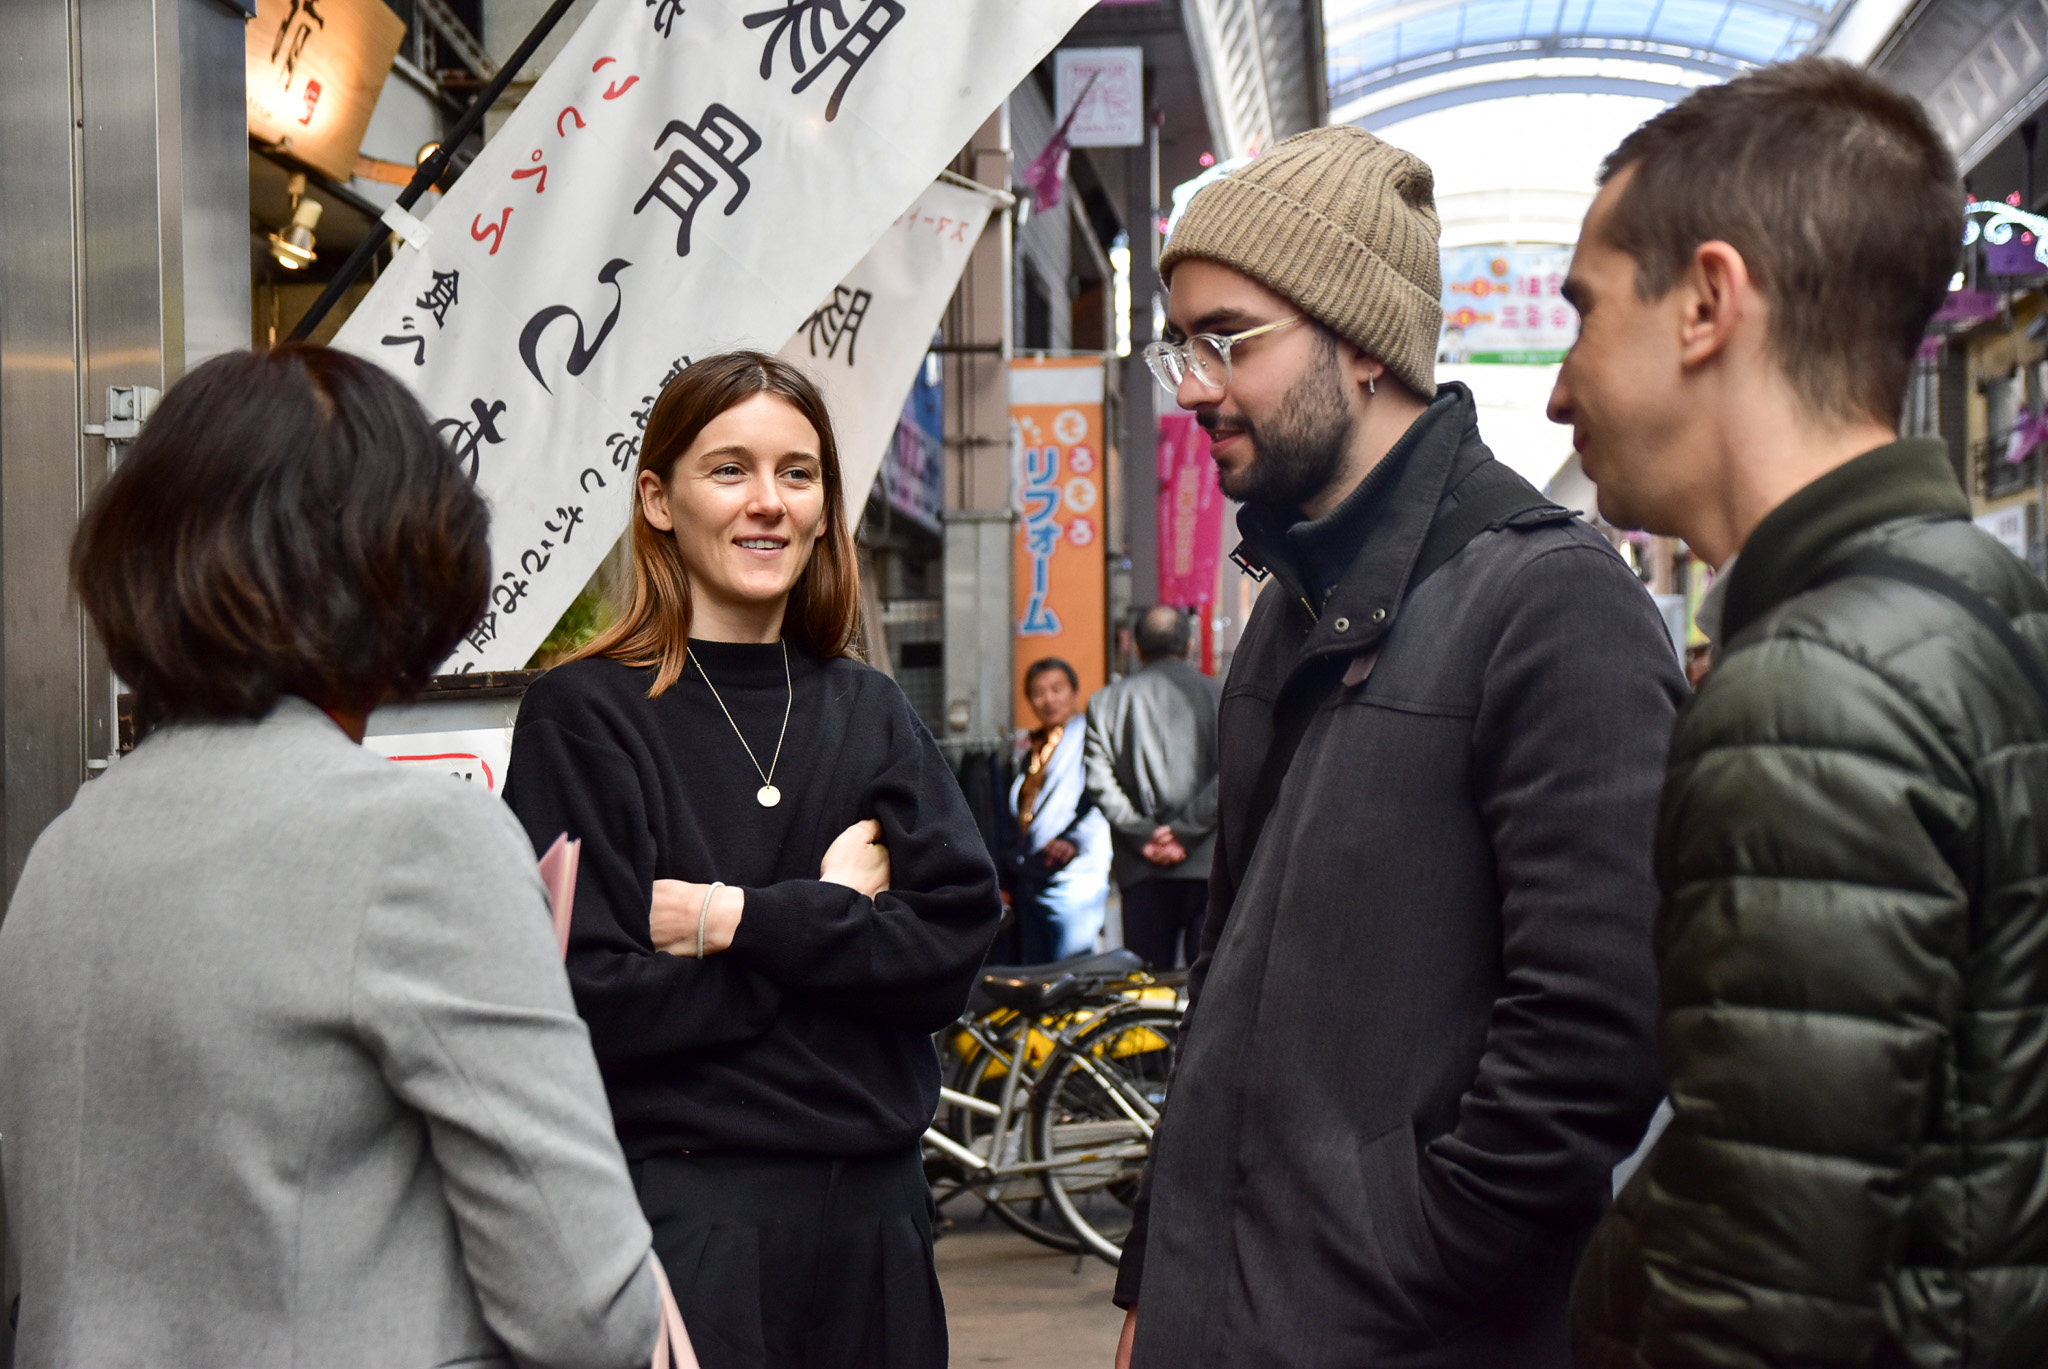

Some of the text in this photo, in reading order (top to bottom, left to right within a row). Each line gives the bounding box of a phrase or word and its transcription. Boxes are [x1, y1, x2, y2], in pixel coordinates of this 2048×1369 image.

[1021, 446, 1062, 634] リフォーム
